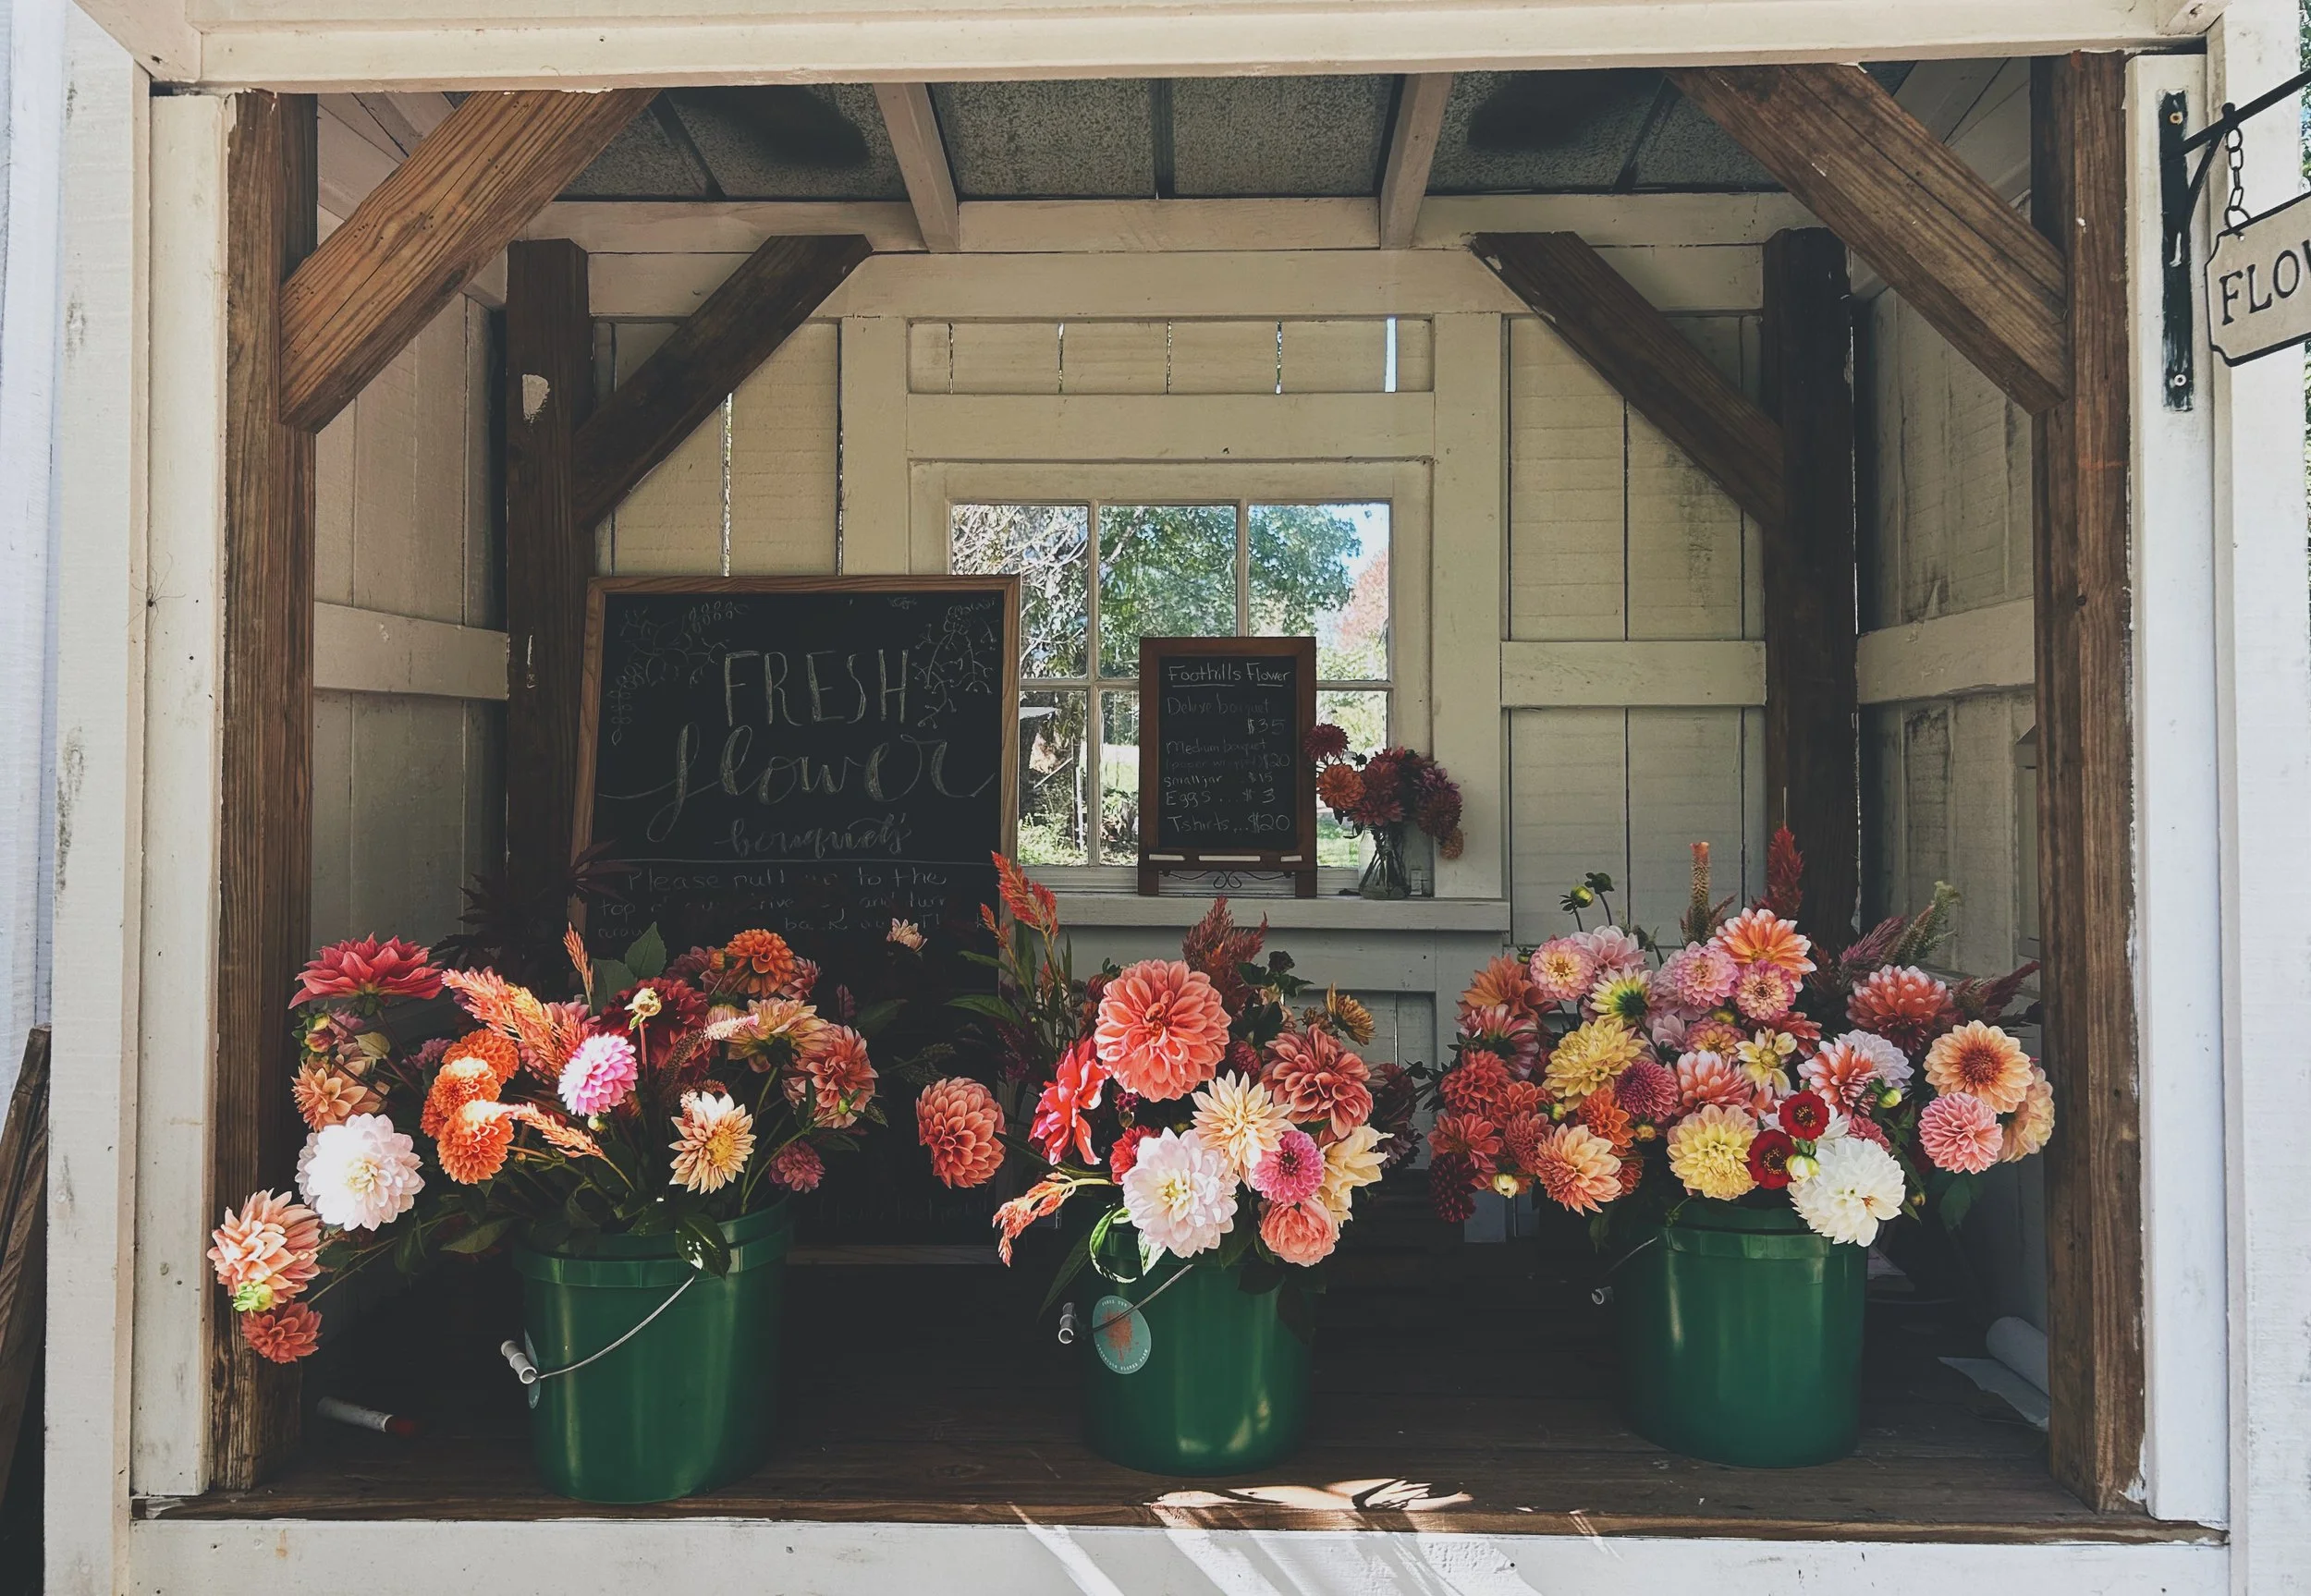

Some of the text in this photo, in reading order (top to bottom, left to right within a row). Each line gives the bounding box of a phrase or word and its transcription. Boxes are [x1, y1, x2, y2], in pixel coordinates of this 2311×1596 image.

[1168, 662, 1291, 682] Foothills Flower
[724, 648, 910, 727] FRESH
[1167, 695, 1212, 716] Deluxe
[1246, 717, 1286, 736] $35
[598, 721, 996, 843] flower
[1165, 791, 1212, 809] Eggs
[628, 866, 721, 892] Please
[857, 866, 882, 886] to
[891, 866, 948, 888] the
[599, 898, 637, 923] top
